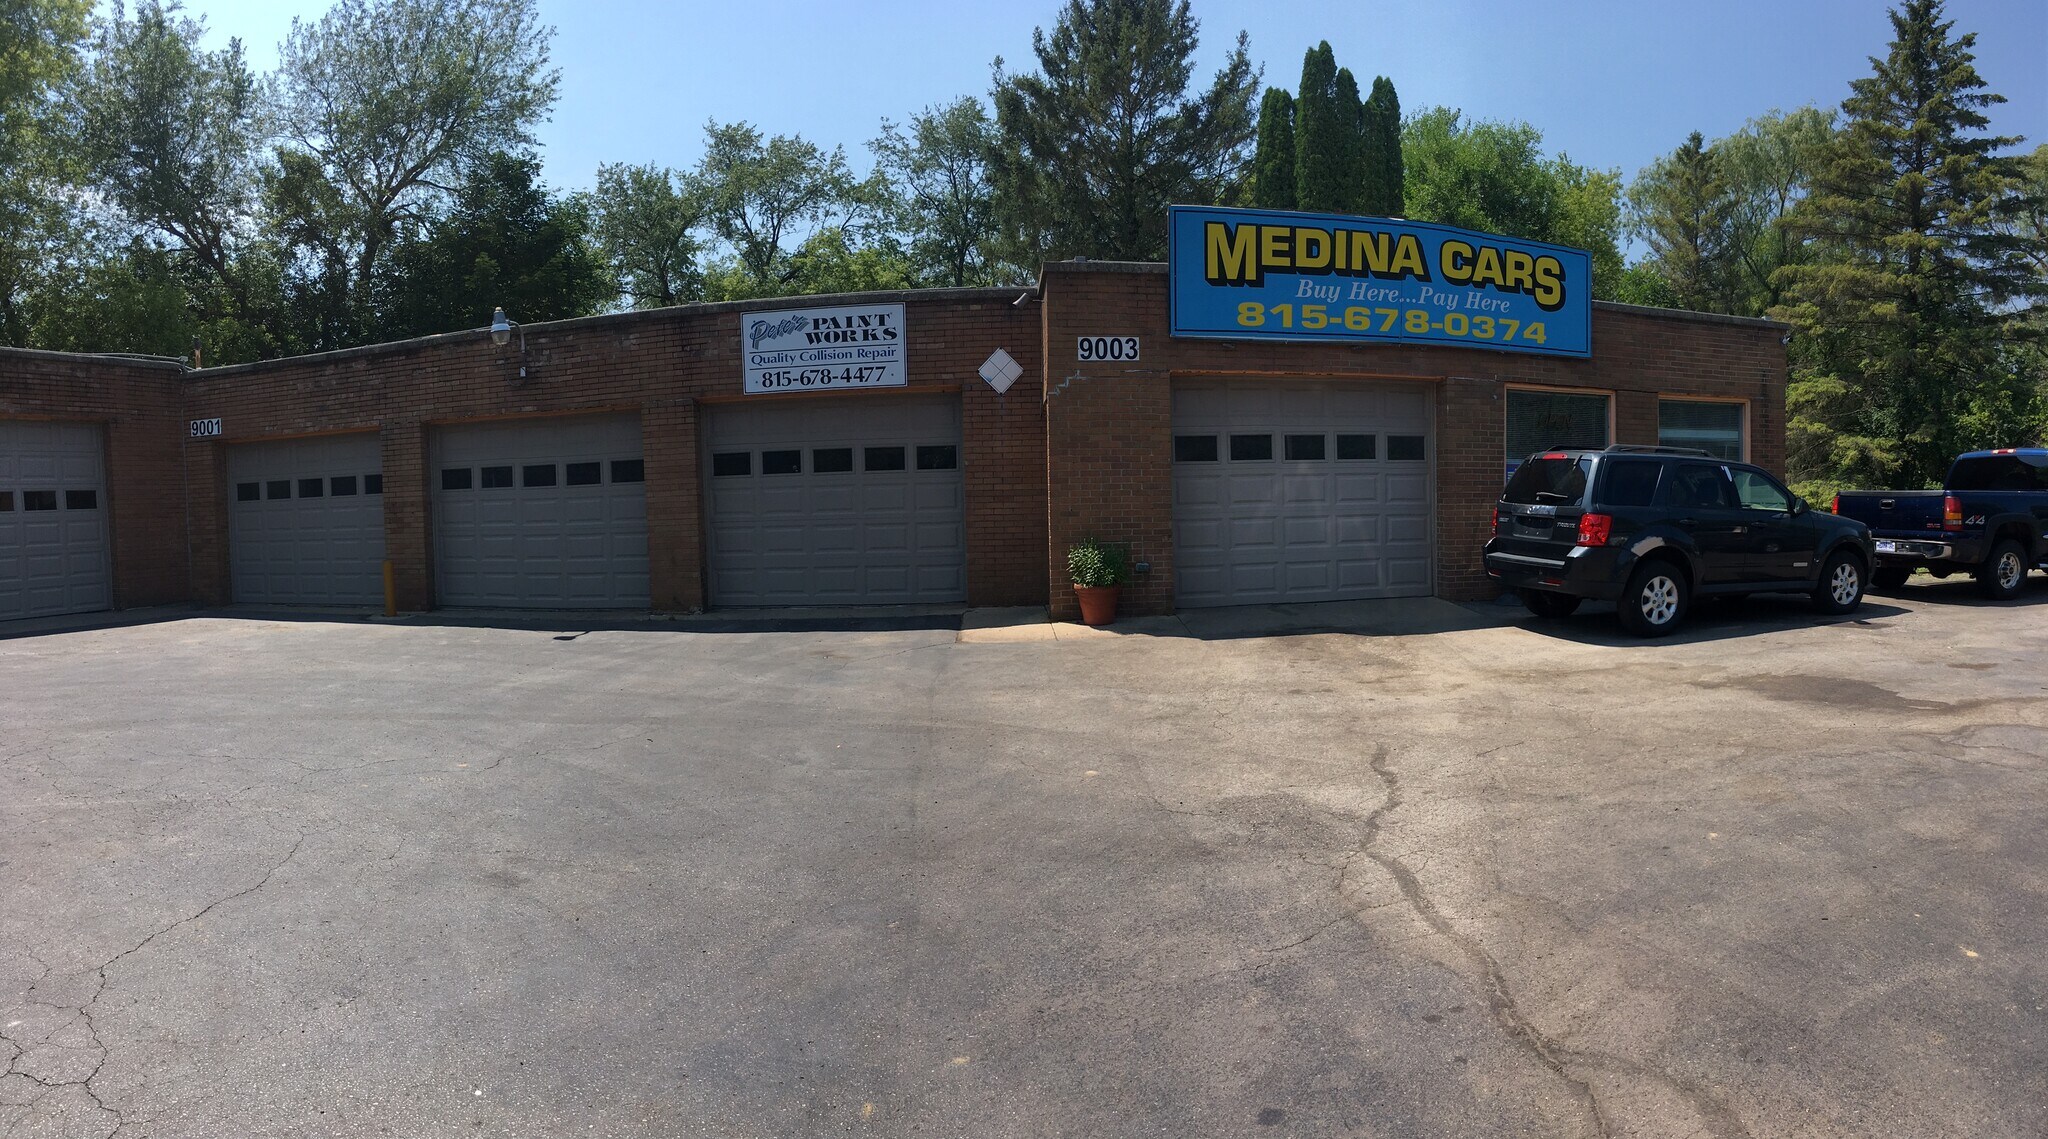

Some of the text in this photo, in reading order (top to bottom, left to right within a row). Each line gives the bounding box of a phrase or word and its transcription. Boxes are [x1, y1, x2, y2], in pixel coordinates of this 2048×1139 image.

[1204, 221, 1566, 312] MEDINA CARS
[1296, 279, 1341, 303] Buy
[1465, 291, 1511, 313] Here
[749, 312, 891, 350] Pete's PAINT
[1237, 302, 1547, 345] 815-678-0374
[804, 326, 898, 346] WORKS
[751, 346, 897, 366] Quality Collision Repair
[1079, 337, 1138, 360] 9003
[761, 366, 887, 388] 815-678-4477
[191, 419, 220, 436] 9001
